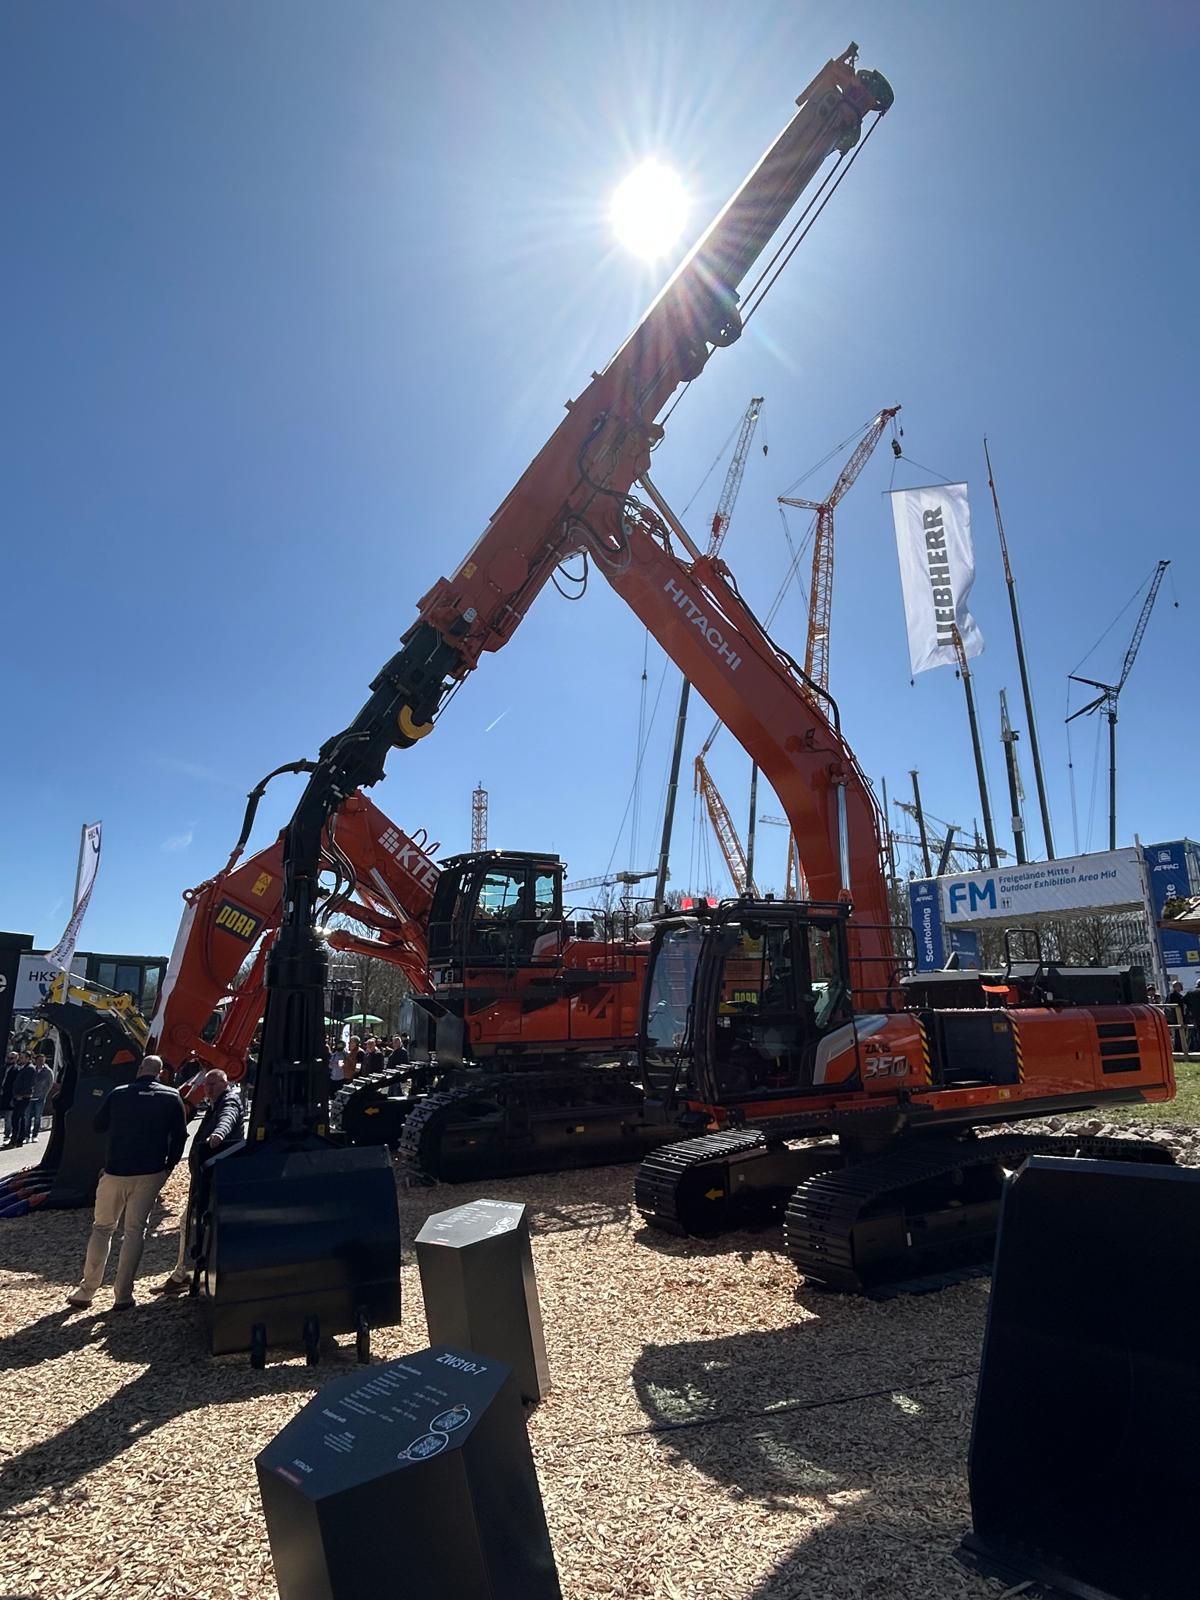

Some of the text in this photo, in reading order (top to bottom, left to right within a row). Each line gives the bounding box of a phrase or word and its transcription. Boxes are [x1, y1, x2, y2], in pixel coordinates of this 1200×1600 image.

[923, 505, 956, 647] LIEBHERR
[663, 579, 742, 671] HITACHI
[396, 843, 440, 893] KTE
[999, 870, 1046, 884] Freigelände
[1047, 867, 1070, 878] Mitte
[1000, 870, 1117, 893] Outdoor Exhibition Area Mid
[950, 879, 997, 914] FM
[923, 907, 934, 963] Scaffolding
[864, 1055, 909, 1079] 350
[436, 1353, 488, 1375] ZW310-7
